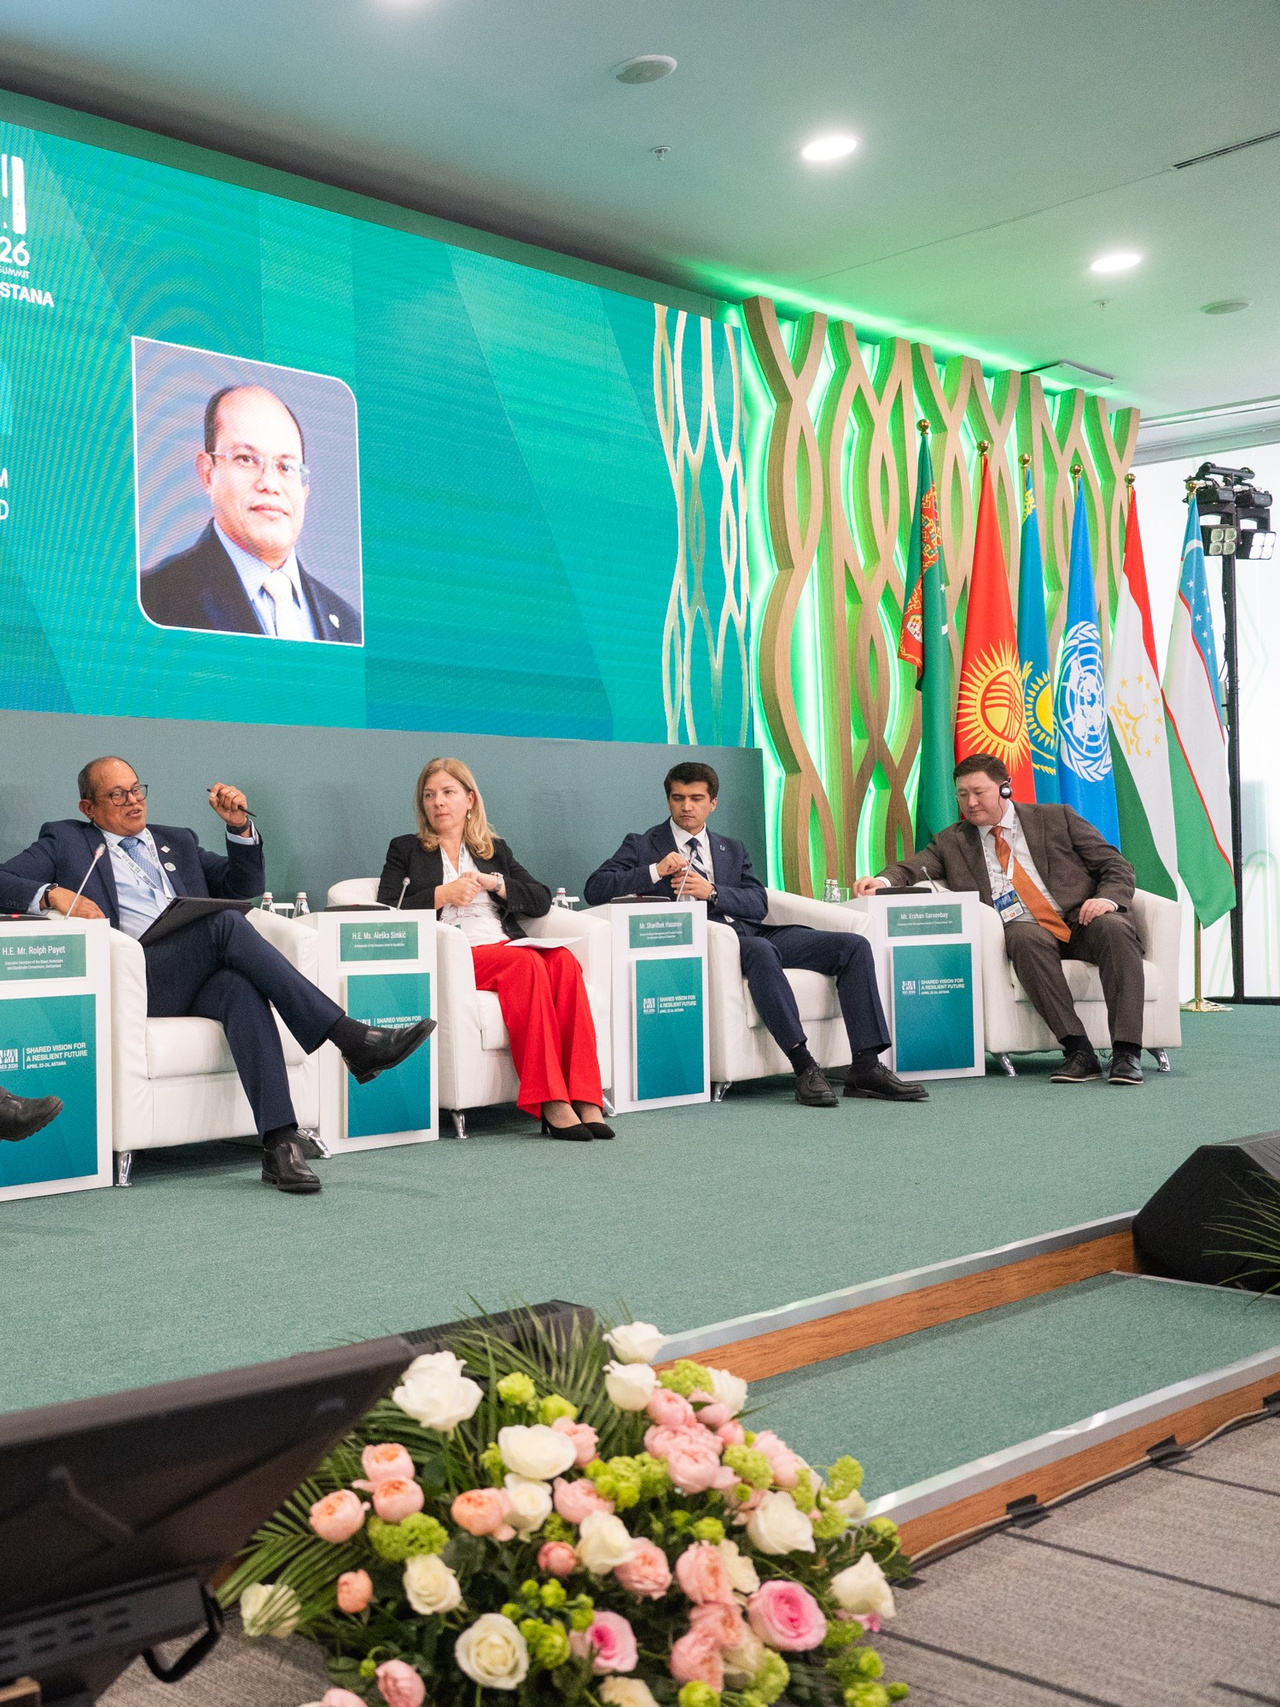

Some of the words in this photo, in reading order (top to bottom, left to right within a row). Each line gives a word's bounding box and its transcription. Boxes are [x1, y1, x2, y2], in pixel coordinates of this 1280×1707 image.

[2, 947, 15, 955] H.E.
[17, 947, 27, 955] Mr.
[29, 946, 46, 956] Rolph
[48, 946, 65, 955] Payet
[26, 1046, 51, 1054] SHARED
[32, 1053, 63, 1061] RESILIENT
[64, 1050, 88, 1058] FUTURE
